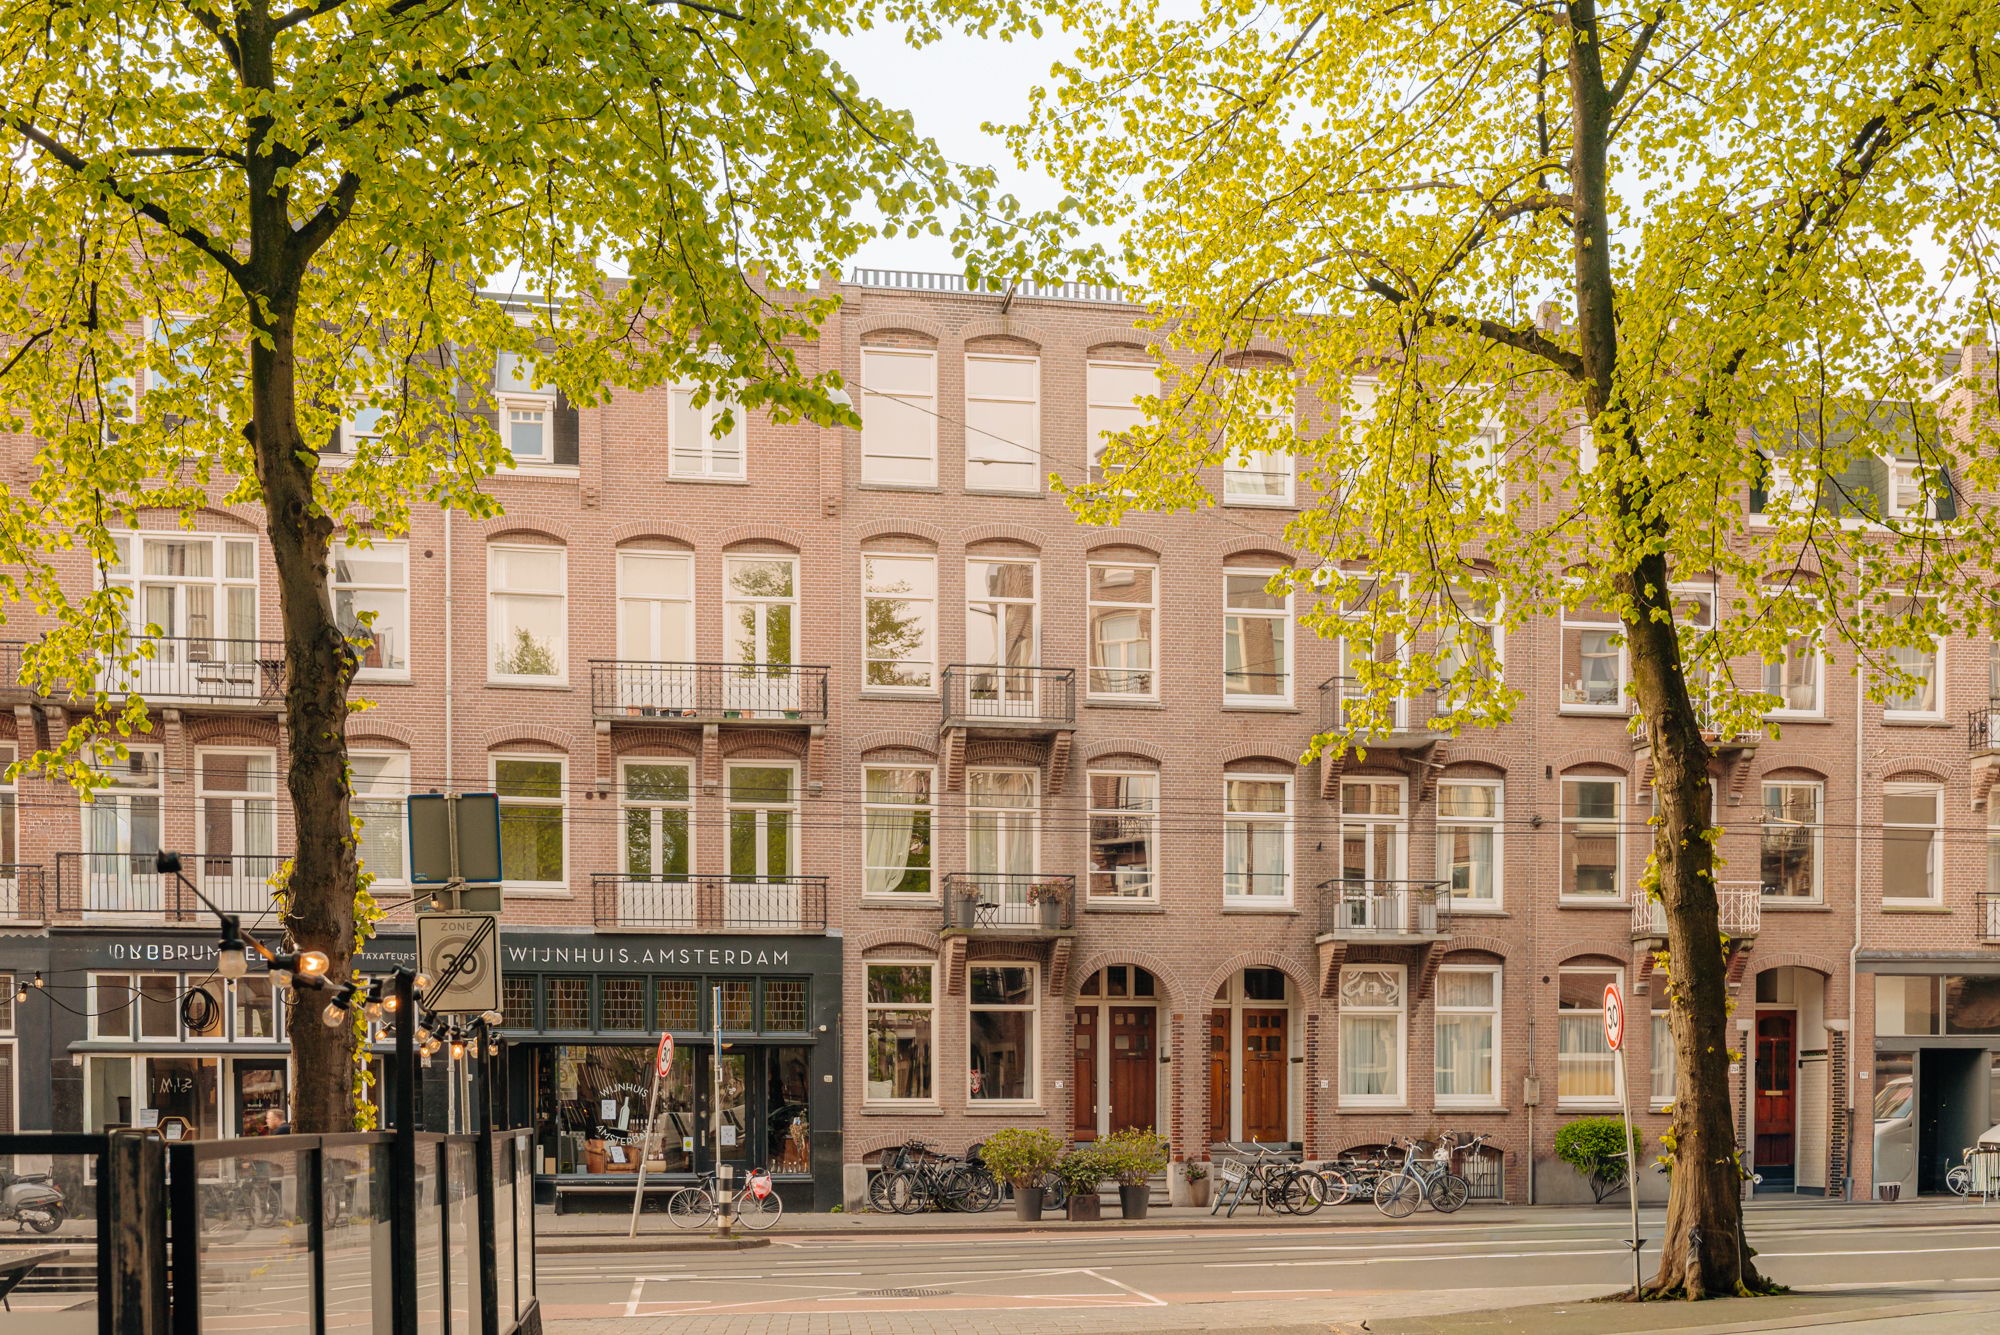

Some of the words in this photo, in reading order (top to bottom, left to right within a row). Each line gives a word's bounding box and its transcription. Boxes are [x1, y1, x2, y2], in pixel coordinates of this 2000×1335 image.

[441, 922, 474, 931] ZONE
[361, 952, 416, 961] TAXATEURS
[441, 953, 477, 975] 30
[1607, 1004, 1618, 1030] 30
[661, 1046, 671, 1064] 30
[600, 1083, 649, 1097] WIJNHUIS
[596, 1125, 649, 1145] AMSTERDA
